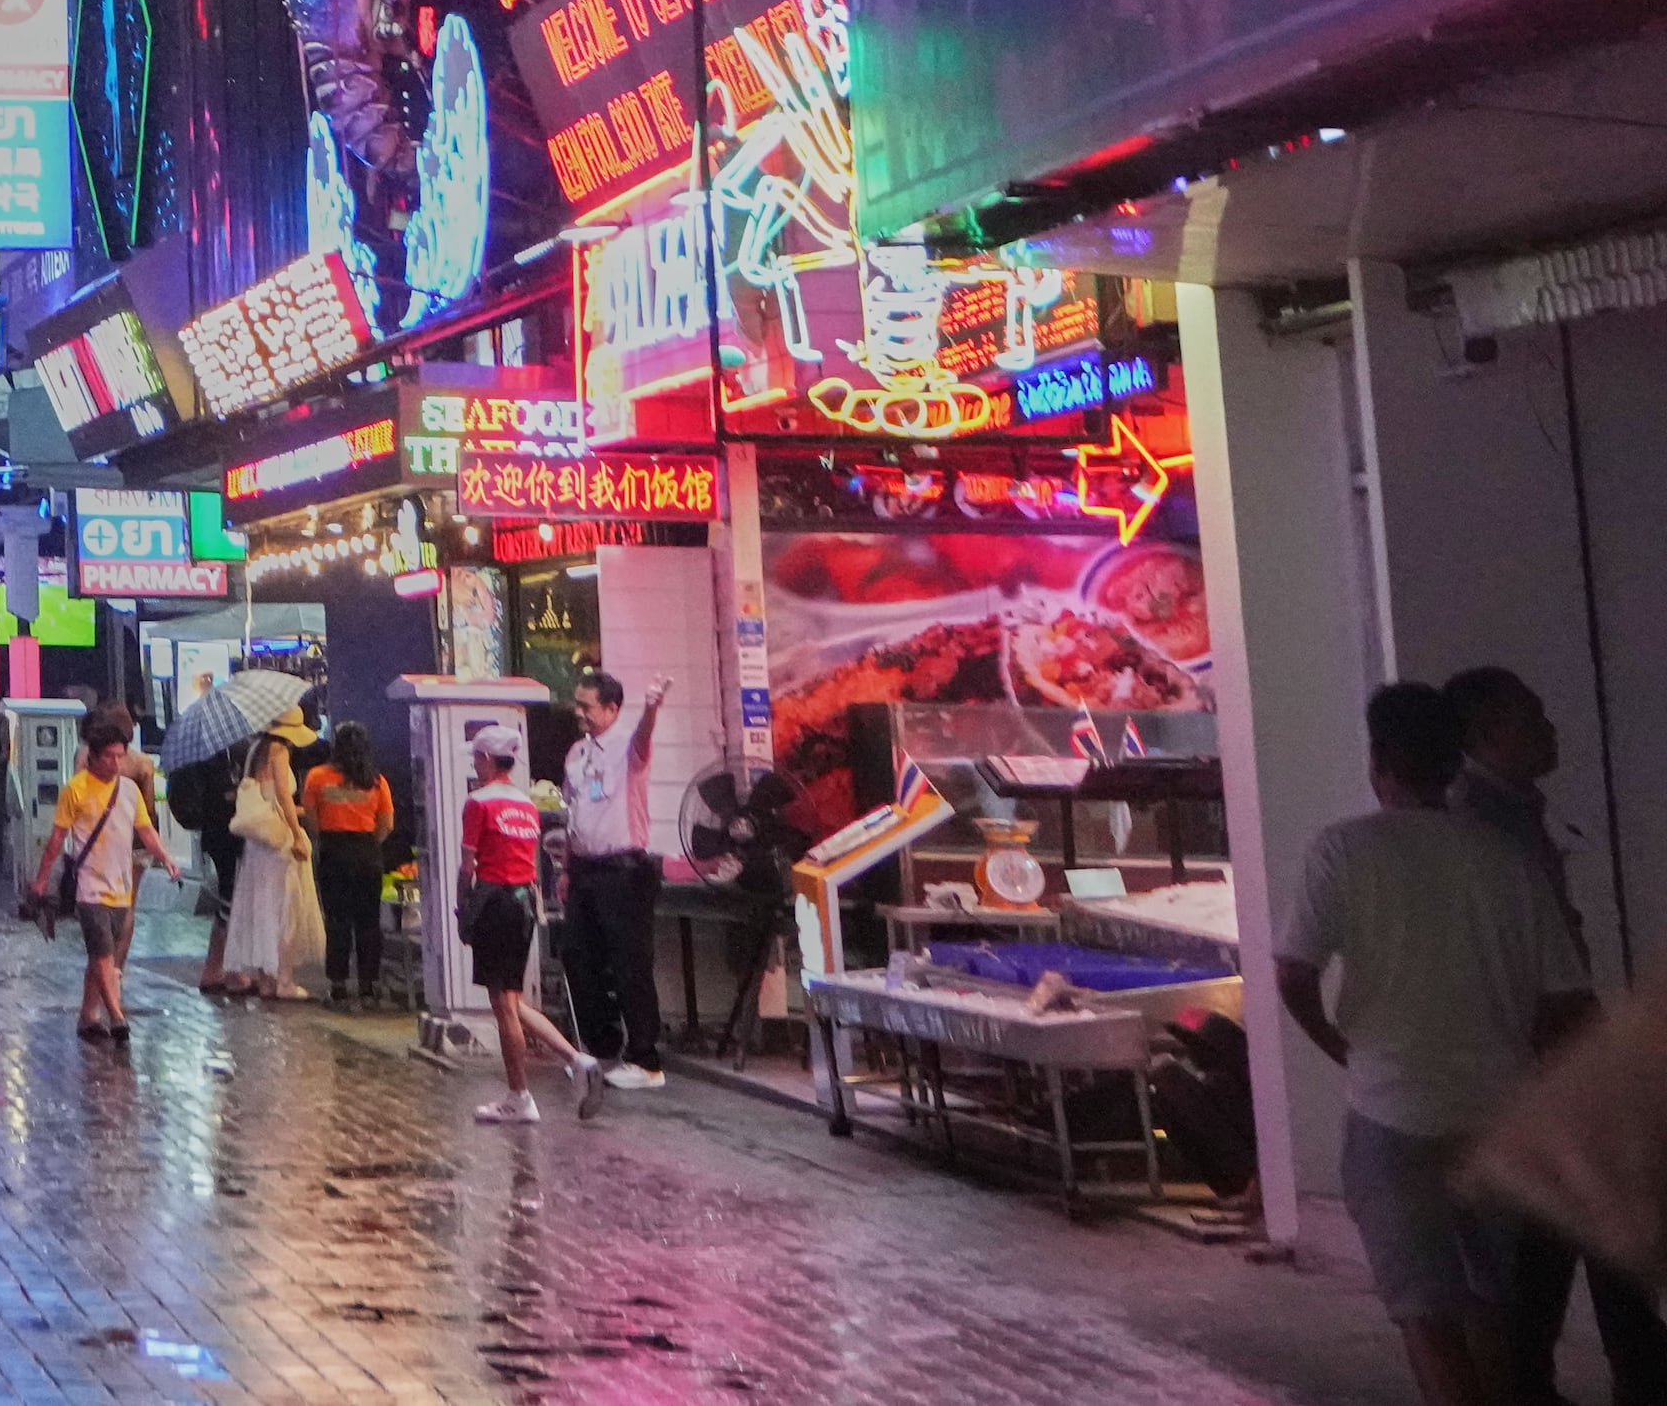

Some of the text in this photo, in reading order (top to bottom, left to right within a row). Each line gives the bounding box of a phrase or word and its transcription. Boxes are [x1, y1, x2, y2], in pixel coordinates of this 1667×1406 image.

[462, 457, 714, 514] 欢迎你到我们饭馆
[82, 564, 222, 593] PHARMACY
